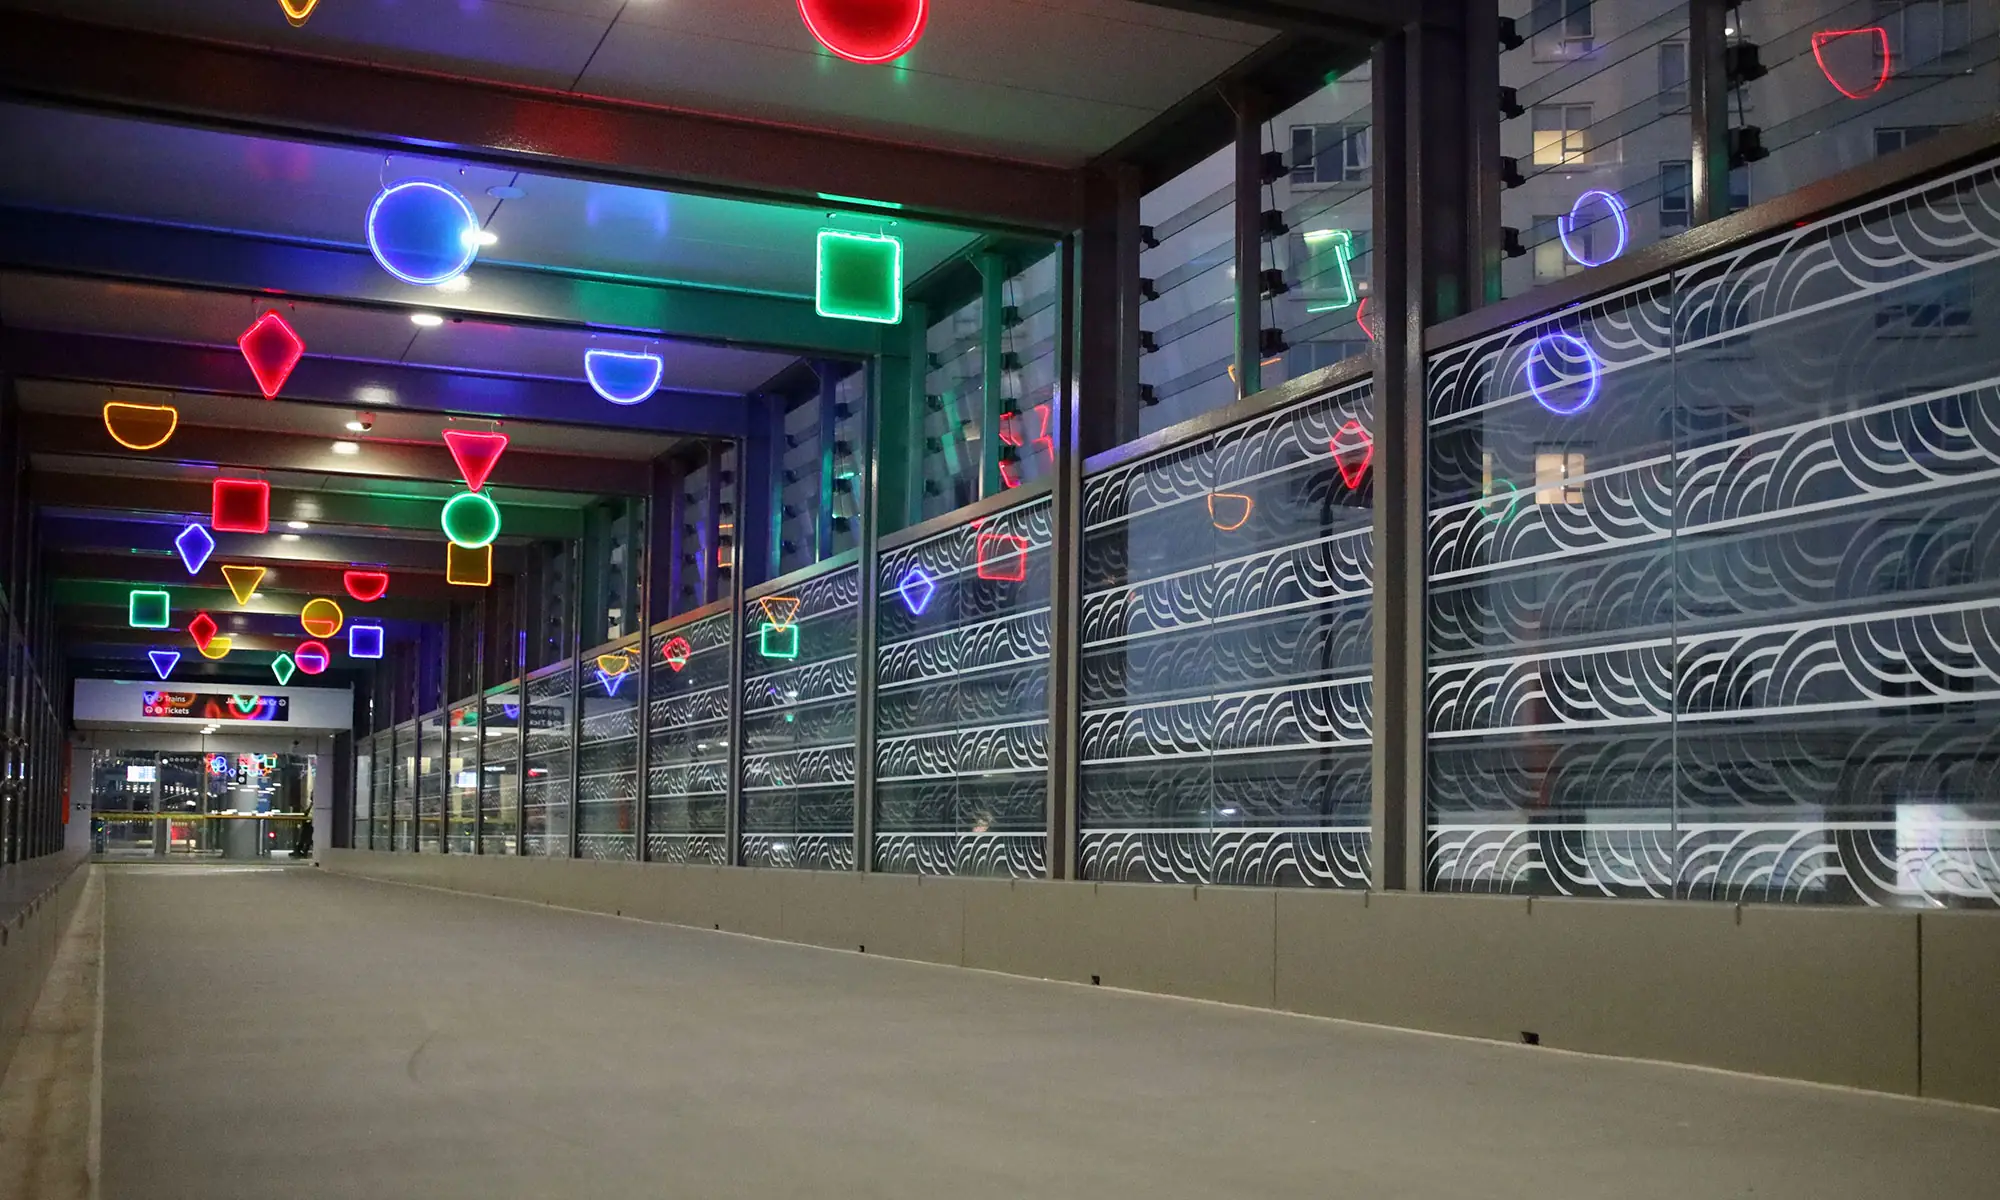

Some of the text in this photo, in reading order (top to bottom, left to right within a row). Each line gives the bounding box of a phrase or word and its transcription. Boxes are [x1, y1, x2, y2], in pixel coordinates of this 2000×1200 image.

[164, 695, 186, 703] Trains
[225, 696, 249, 705] Jas
[164, 706, 190, 715] Tickets
